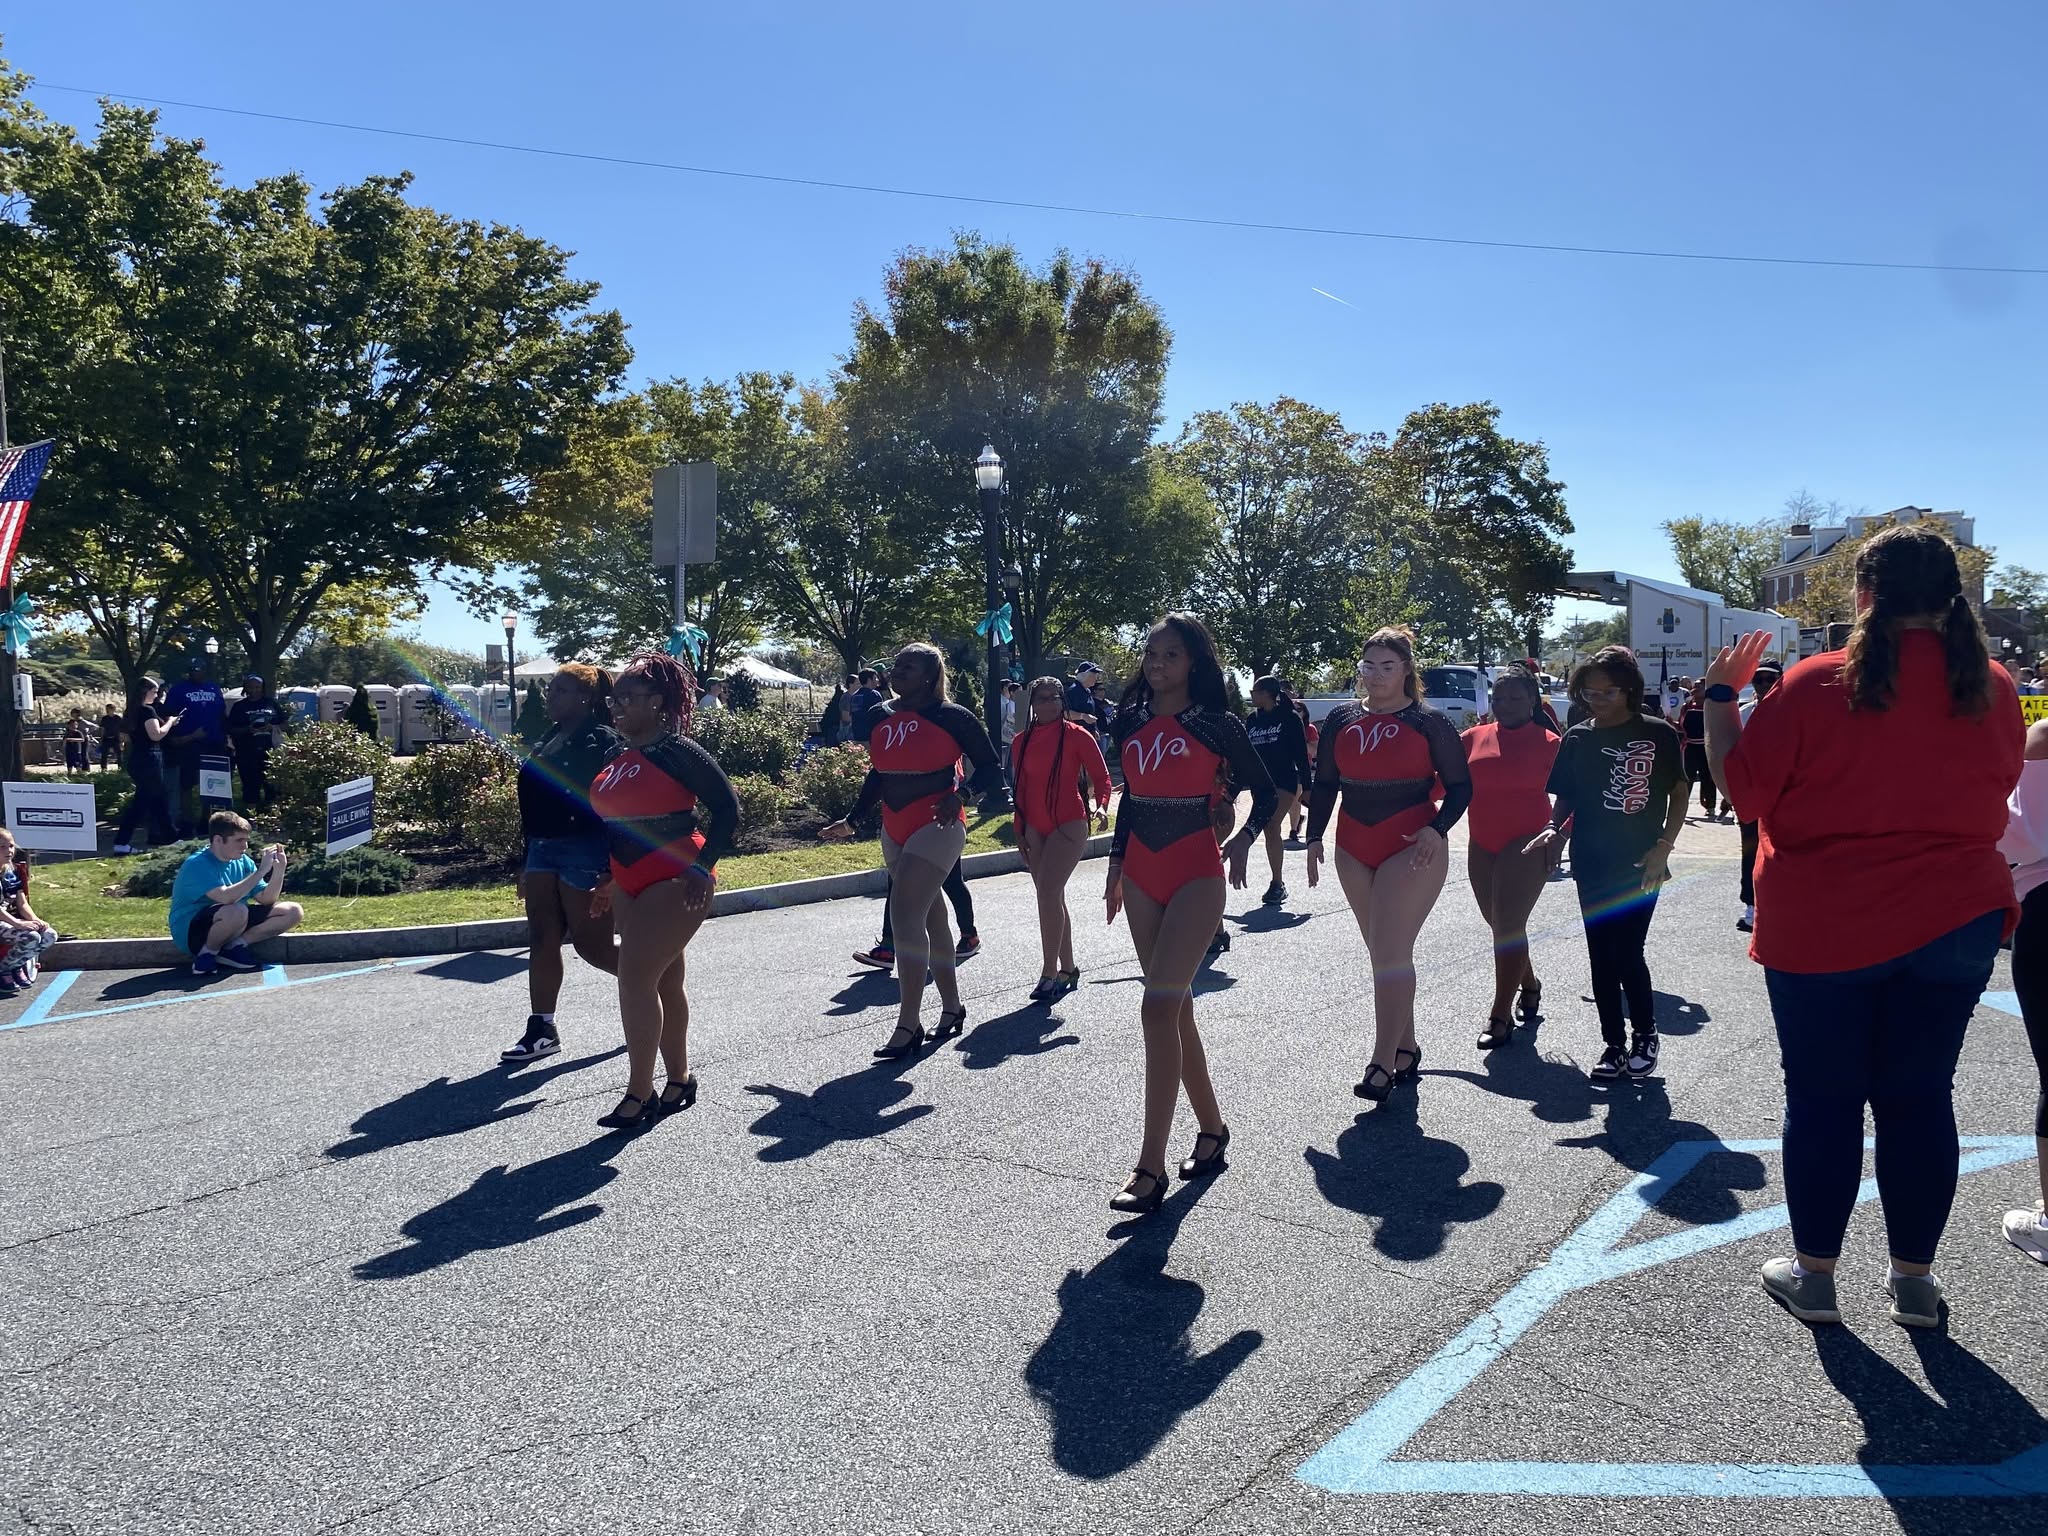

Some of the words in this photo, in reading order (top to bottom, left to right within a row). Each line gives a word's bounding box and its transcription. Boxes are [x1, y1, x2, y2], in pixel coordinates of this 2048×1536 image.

[1635, 649, 1674, 659] Communty
[1676, 649, 1703, 658] Services
[1602, 764, 1625, 810] Class
[1623, 740, 1655, 814] 2026
[20, 810, 82, 823] casella
[332, 813, 349, 827] SAUL
[350, 806, 370, 821] EWING
